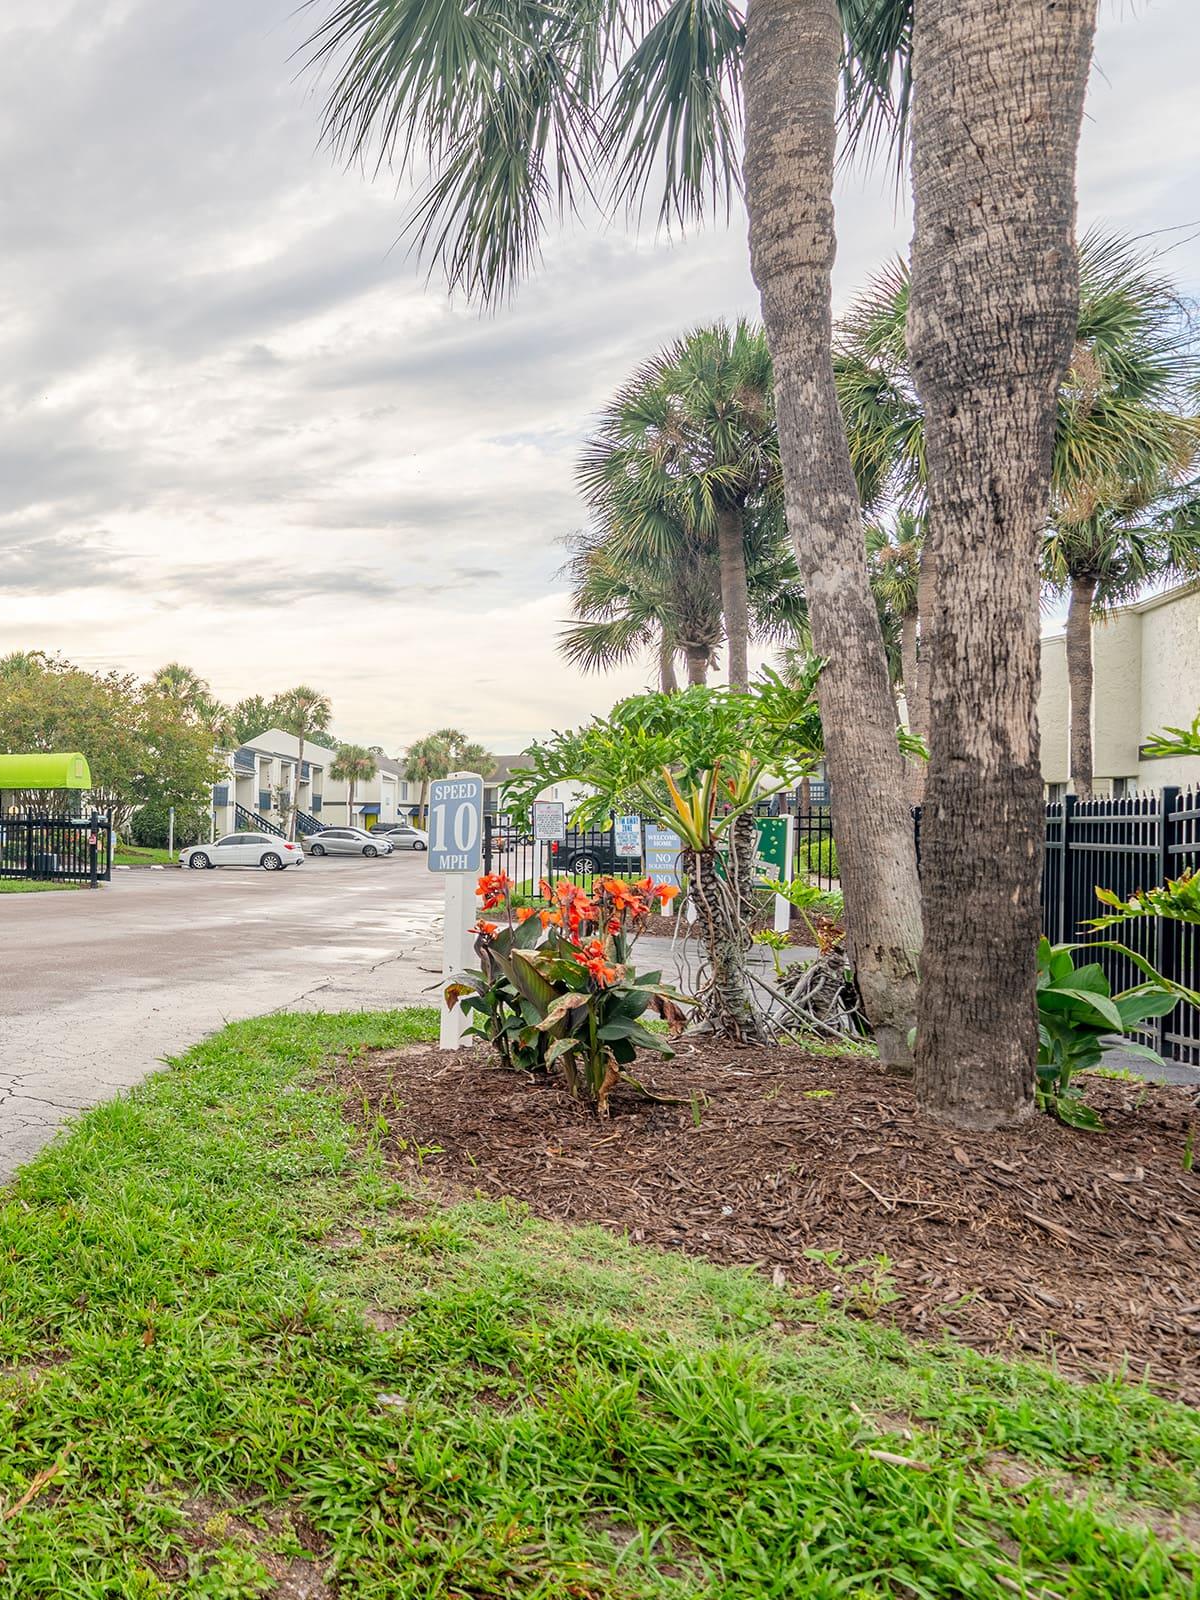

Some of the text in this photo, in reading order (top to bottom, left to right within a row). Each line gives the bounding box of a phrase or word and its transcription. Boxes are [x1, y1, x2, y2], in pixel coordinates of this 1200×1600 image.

[434, 783, 477, 801] SPEED
[432, 802, 478, 852] 10
[439, 854, 469, 870] MPH
[655, 853, 671, 863] NO
[656, 874, 672, 884] NO
